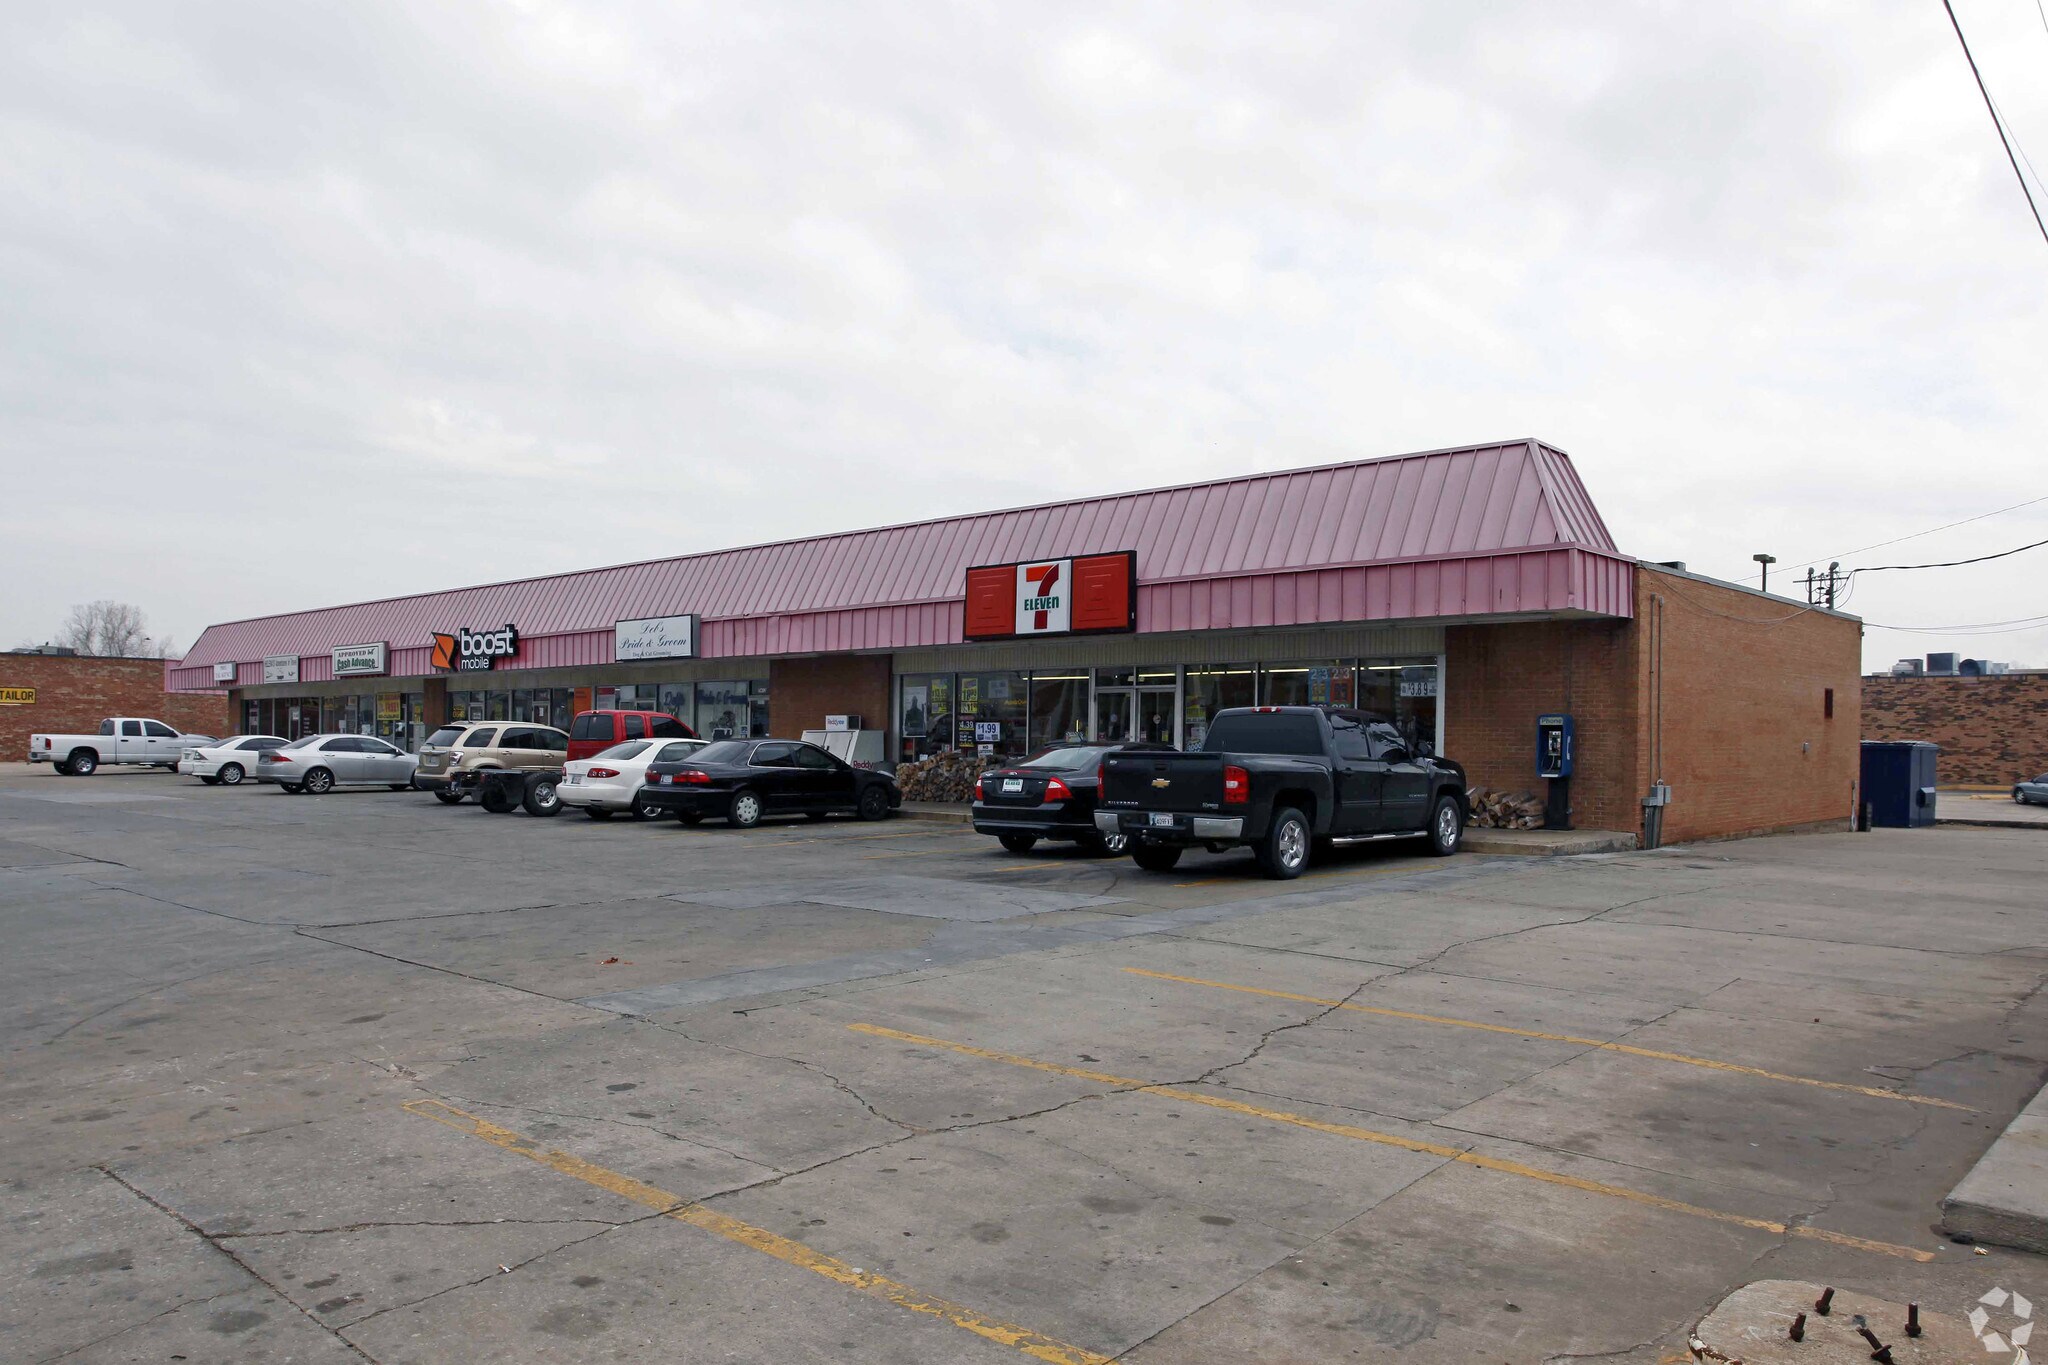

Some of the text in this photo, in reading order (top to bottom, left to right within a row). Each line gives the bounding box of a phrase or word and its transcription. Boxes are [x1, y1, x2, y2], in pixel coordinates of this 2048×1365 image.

[1026, 564, 1059, 629] 7
[461, 627, 514, 656] boost
[619, 635, 687, 649] Pride & Groom
[337, 657, 376, 671] Cash Advance
[461, 657, 489, 670] mobile
[0, 690, 34, 701] TAILOR
[977, 723, 997, 734] $1.99
